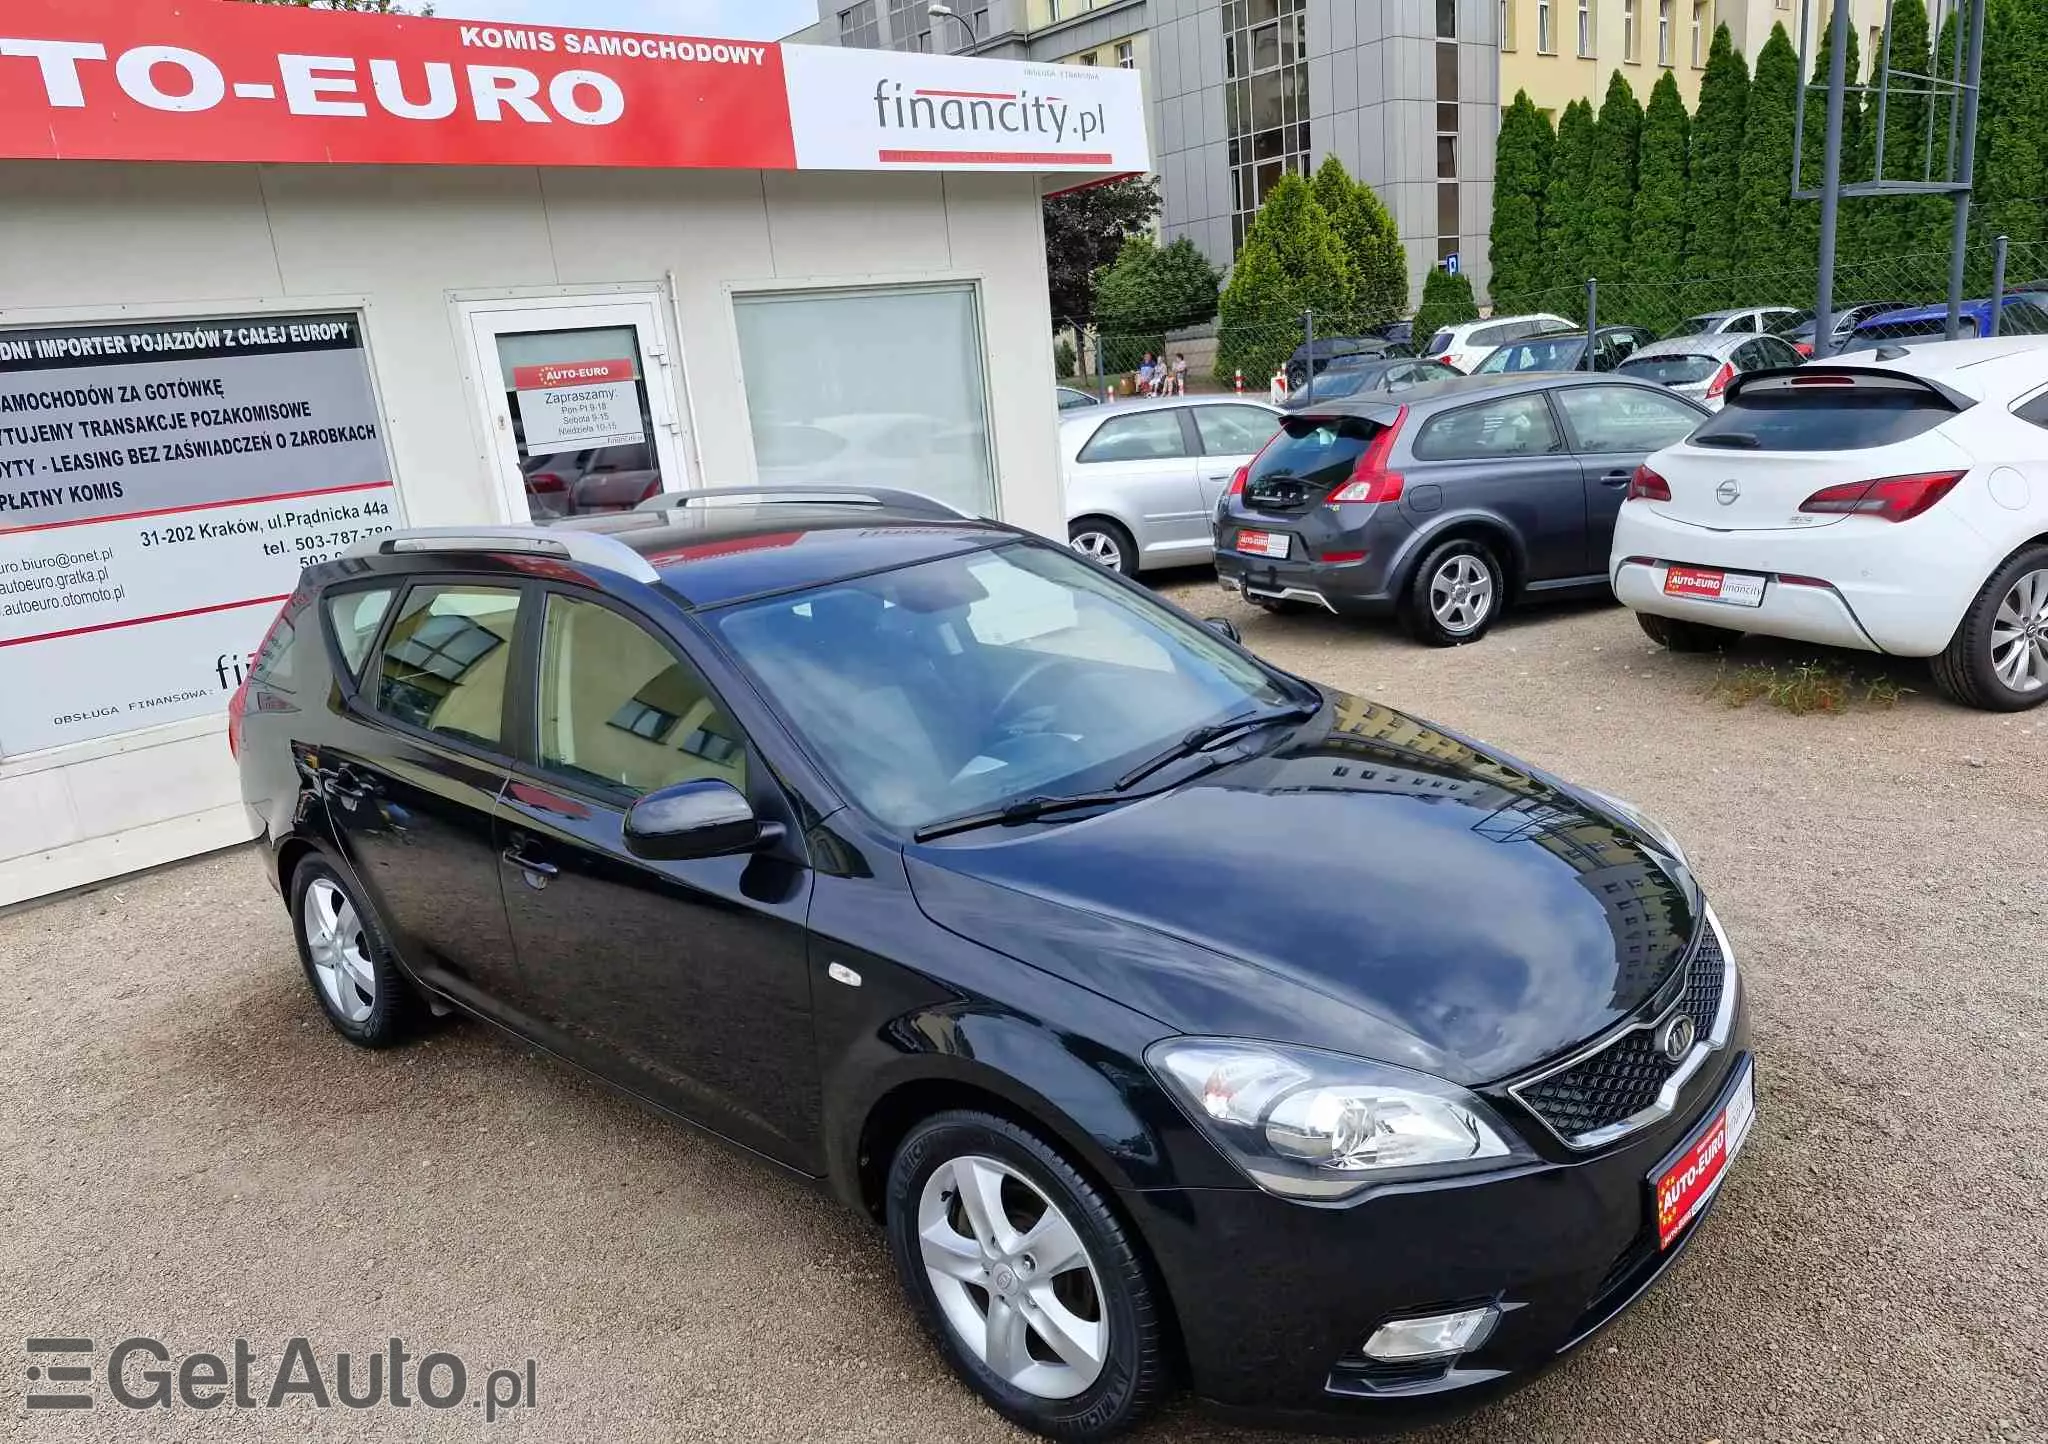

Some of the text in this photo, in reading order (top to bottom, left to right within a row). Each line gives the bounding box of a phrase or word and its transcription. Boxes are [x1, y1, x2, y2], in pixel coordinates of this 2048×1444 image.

[460, 26, 766, 66] KOMIS SAMOCHODOWY
[0, 37, 625, 126] TO-EURO
[874, 79, 1105, 143] financity.pl
[35, 335, 128, 359] IMPORTER
[131, 327, 220, 352] POJAZDÓW
[223, 329, 236, 347] Z
[238, 326, 287, 344] CAŁEJ
[289, 323, 348, 342] EUROPY
[118, 385, 141, 403] ZA
[145, 377, 225, 400] GOTÓWKĘ
[546, 367, 609, 381] AUTO-EURO
[0, 402, 311, 446] TUJEMY TRANSAKCJE POZAKOMISOWE
[0, 458, 35, 479] YTY
[50, 449, 124, 474] LEASING
[128, 446, 160, 465] BEZ
[164, 431, 273, 461] ZAŚWIADCZEŃ
[275, 433, 287, 449] O
[291, 424, 376, 448] ZAROBKACH
[68, 481, 123, 503] KOMIS
[140, 501, 389, 547] 31-202 Kraków, ul.Prądnicka 44a
[263, 540, 290, 556] tel.
[1672, 575, 1720, 590] AUTO-EURO
[54, 706, 120, 726] OBSŁUGA
[1664, 1129, 1724, 1212] AUTO-EURO
